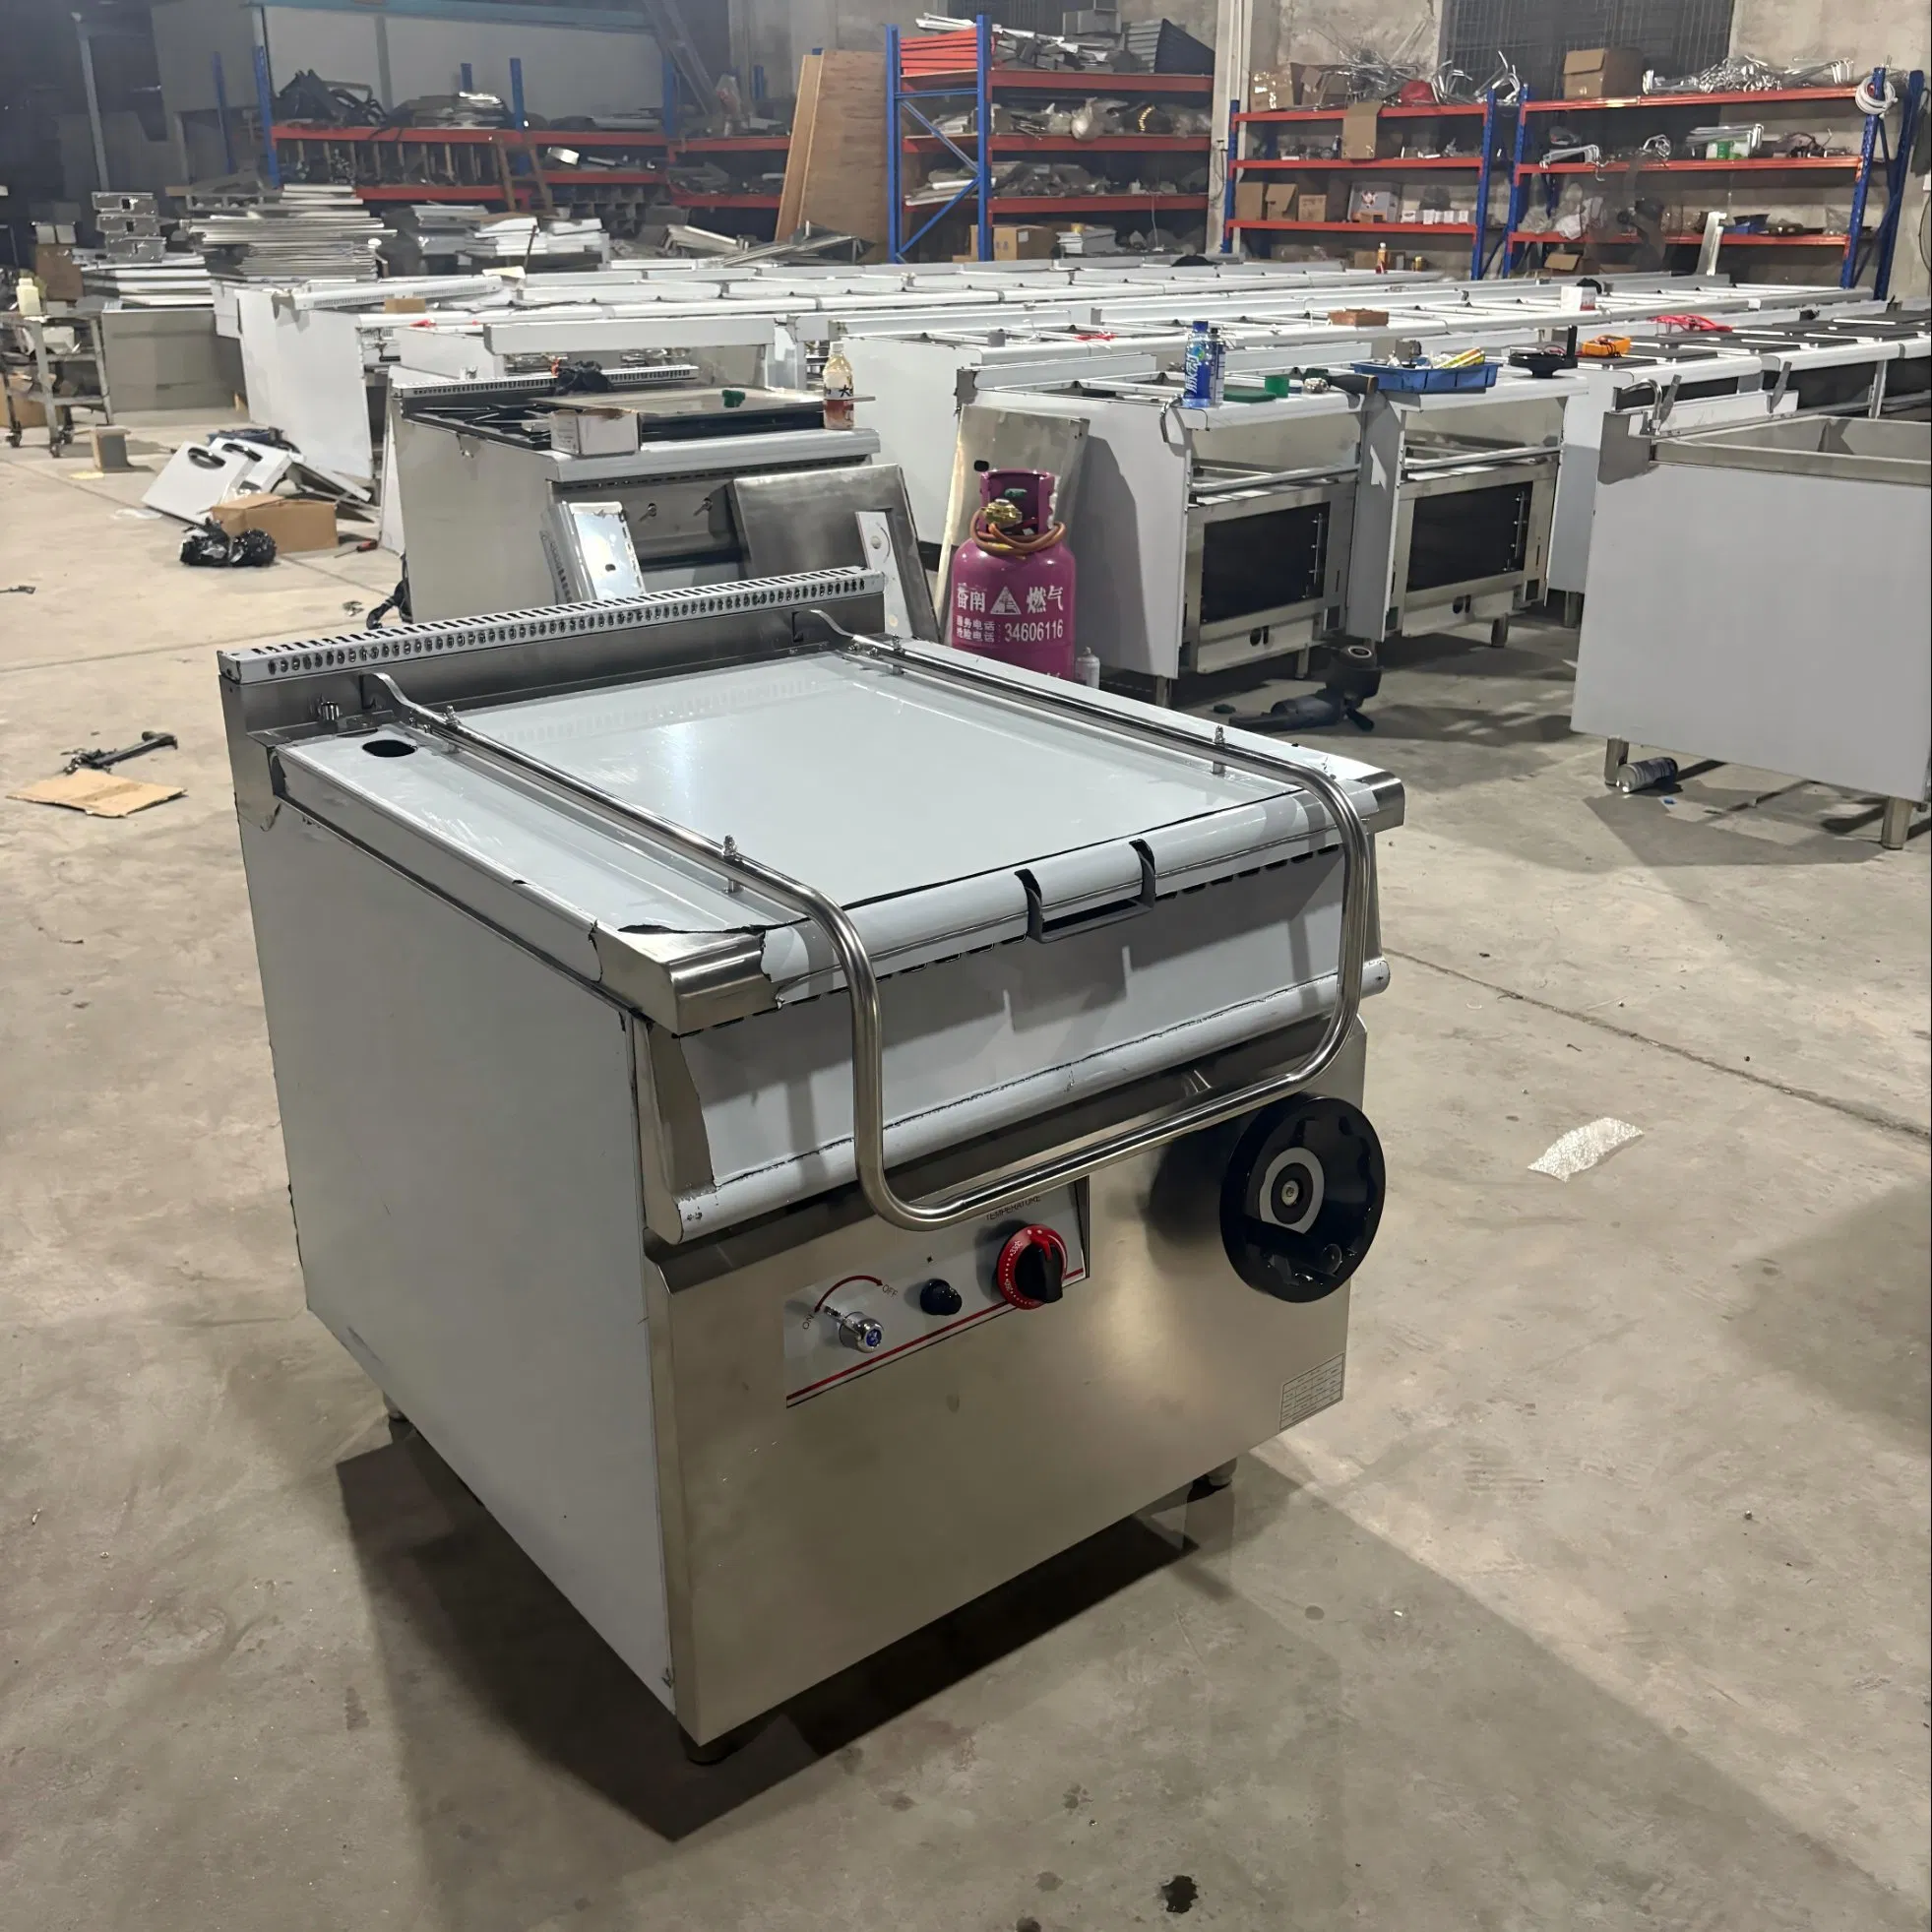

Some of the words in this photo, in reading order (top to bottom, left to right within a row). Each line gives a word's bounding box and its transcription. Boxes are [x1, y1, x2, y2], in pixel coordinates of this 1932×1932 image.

[1027, 585, 1064, 613] 燃气
[1004, 619, 1064, 643] 34606116
[986, 1197, 1040, 1220] TEMPERATURE
[882, 1284, 898, 1297] OFF
[802, 1314, 814, 1330] ON
